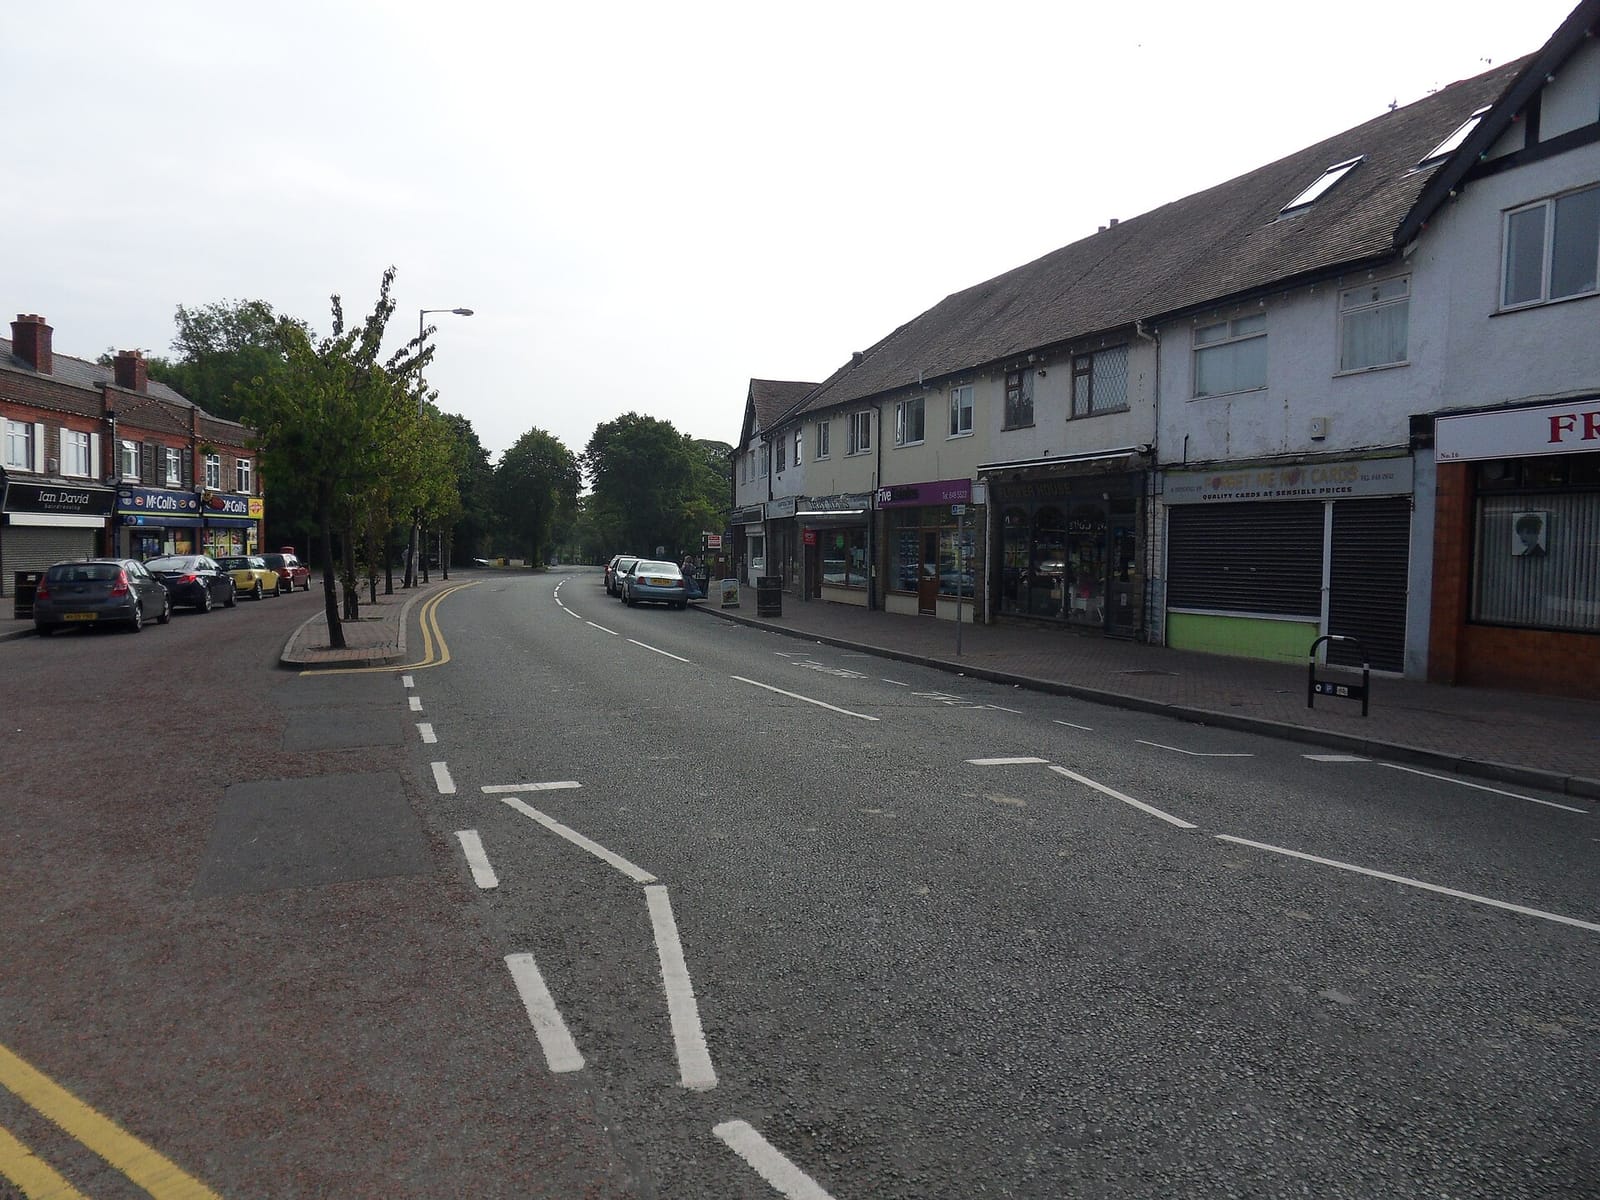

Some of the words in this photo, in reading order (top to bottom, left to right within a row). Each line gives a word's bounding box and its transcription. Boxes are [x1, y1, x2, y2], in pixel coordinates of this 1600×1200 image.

[1256, 470, 1276, 487] ME
[1310, 464, 1360, 485] CARDS
[38, 491, 56, 502] Ian
[59, 492, 90, 504] David
[878, 488, 892, 502] Five
[1276, 488, 1316, 496] SENSIBLE
[1319, 486, 1352, 494] PRICES
[145, 495, 177, 510] McColl's
